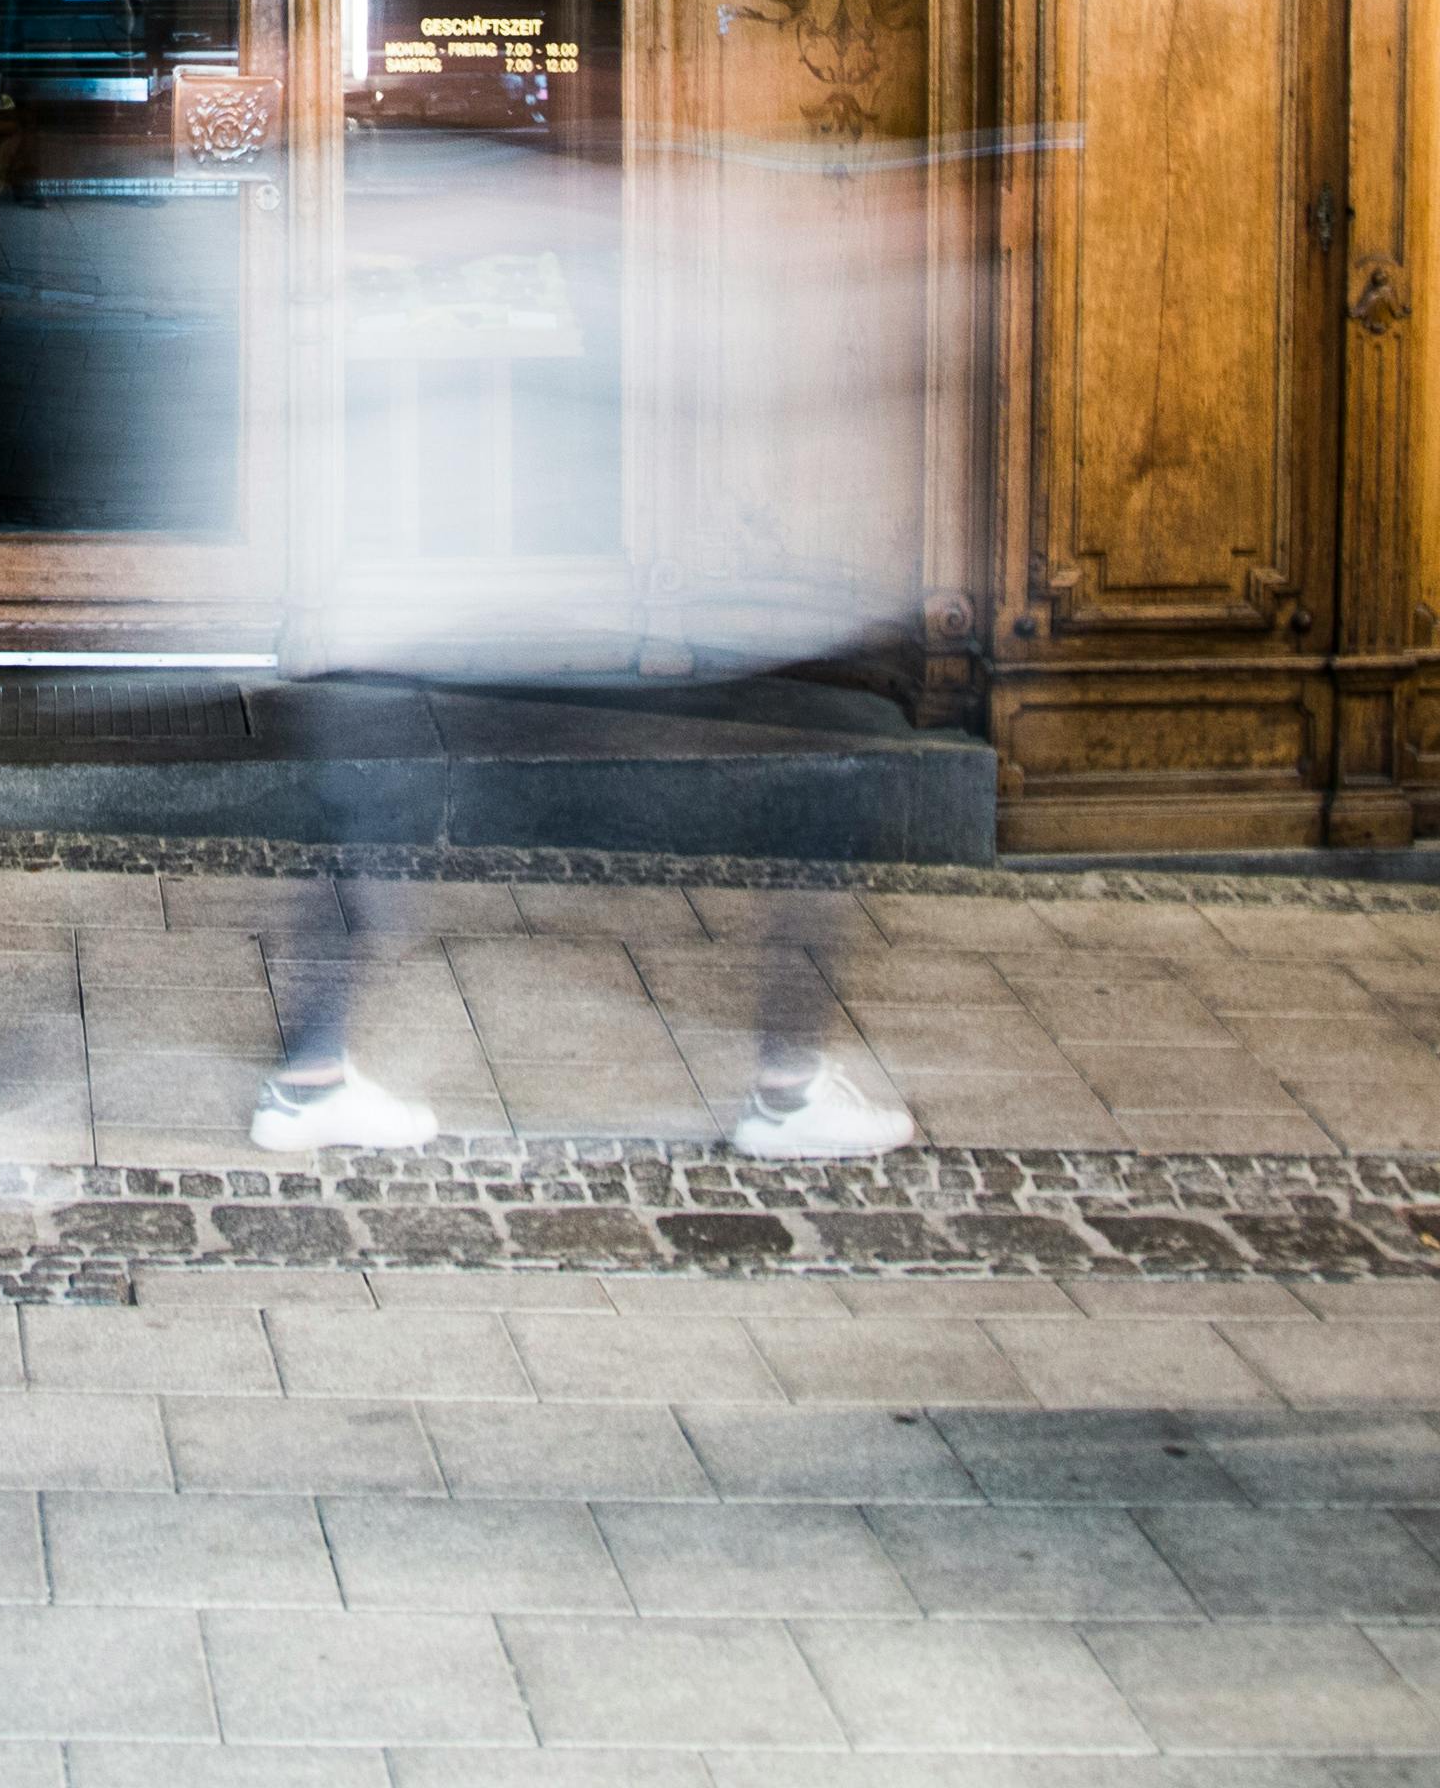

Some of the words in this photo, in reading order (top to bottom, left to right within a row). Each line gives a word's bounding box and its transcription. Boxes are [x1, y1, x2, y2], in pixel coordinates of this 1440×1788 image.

[421, 15, 544, 36] GESCHÄFTSZEIT
[384, 42, 436, 57] MONTAG
[448, 42, 498, 57] FREITAG
[385, 57, 443, 73] SAMSTAG
